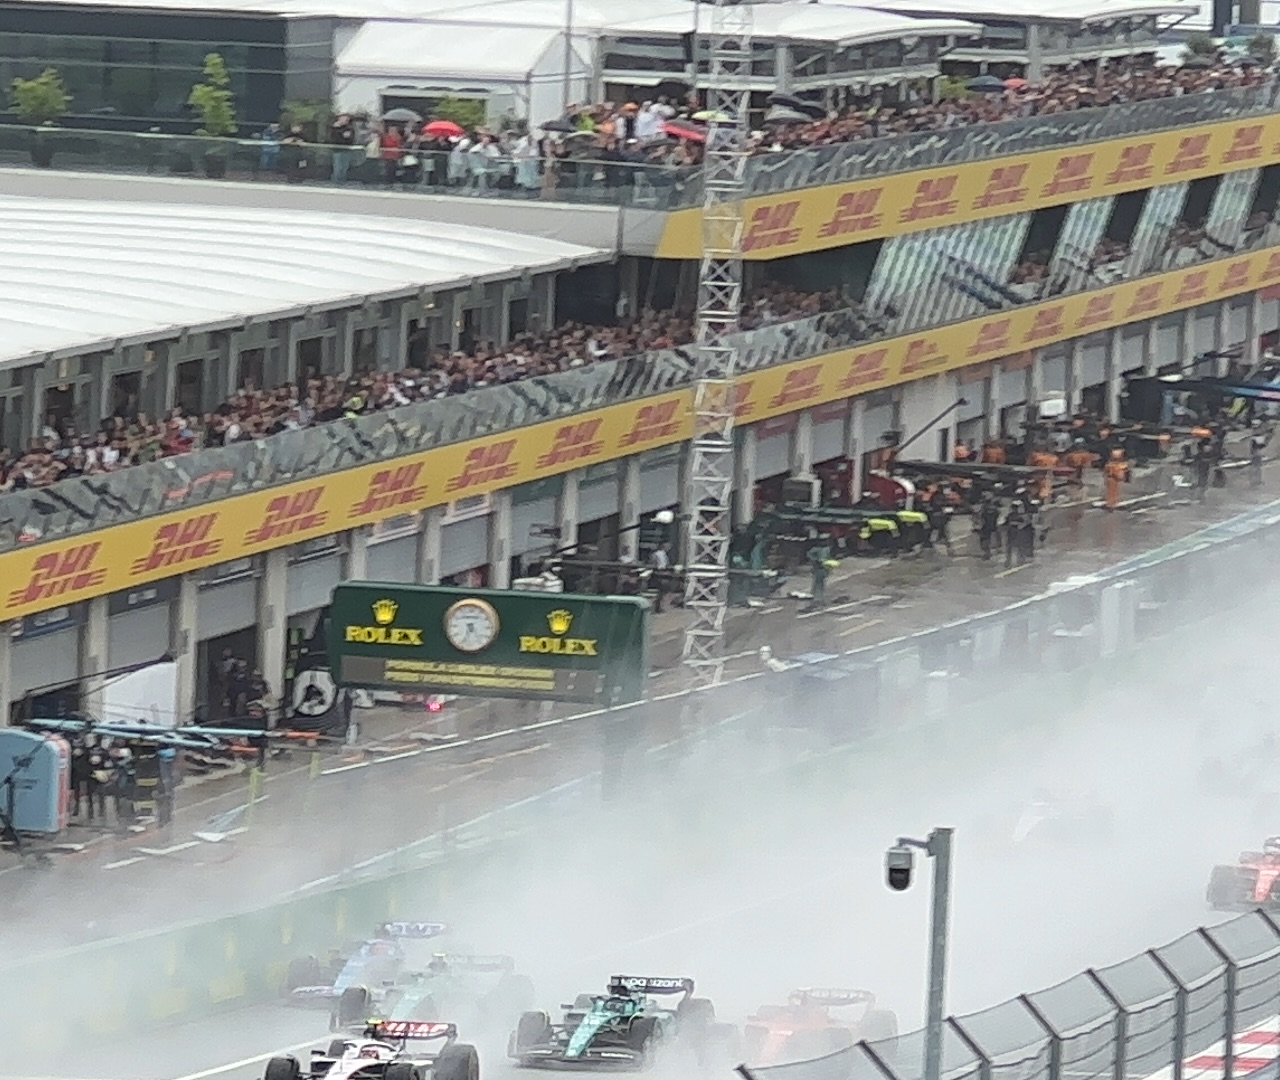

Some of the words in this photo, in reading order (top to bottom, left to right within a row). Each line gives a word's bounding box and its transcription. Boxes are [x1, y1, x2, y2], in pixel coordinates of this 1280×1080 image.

[7, 542, 106, 608] DHL
[131, 514, 223, 575] DHL
[246, 487, 329, 546] DHL
[351, 461, 428, 518] DHL
[445, 440, 519, 493] DHL
[345, 626, 423, 646] ROLEX
[519, 635, 598, 656] ROLEX
